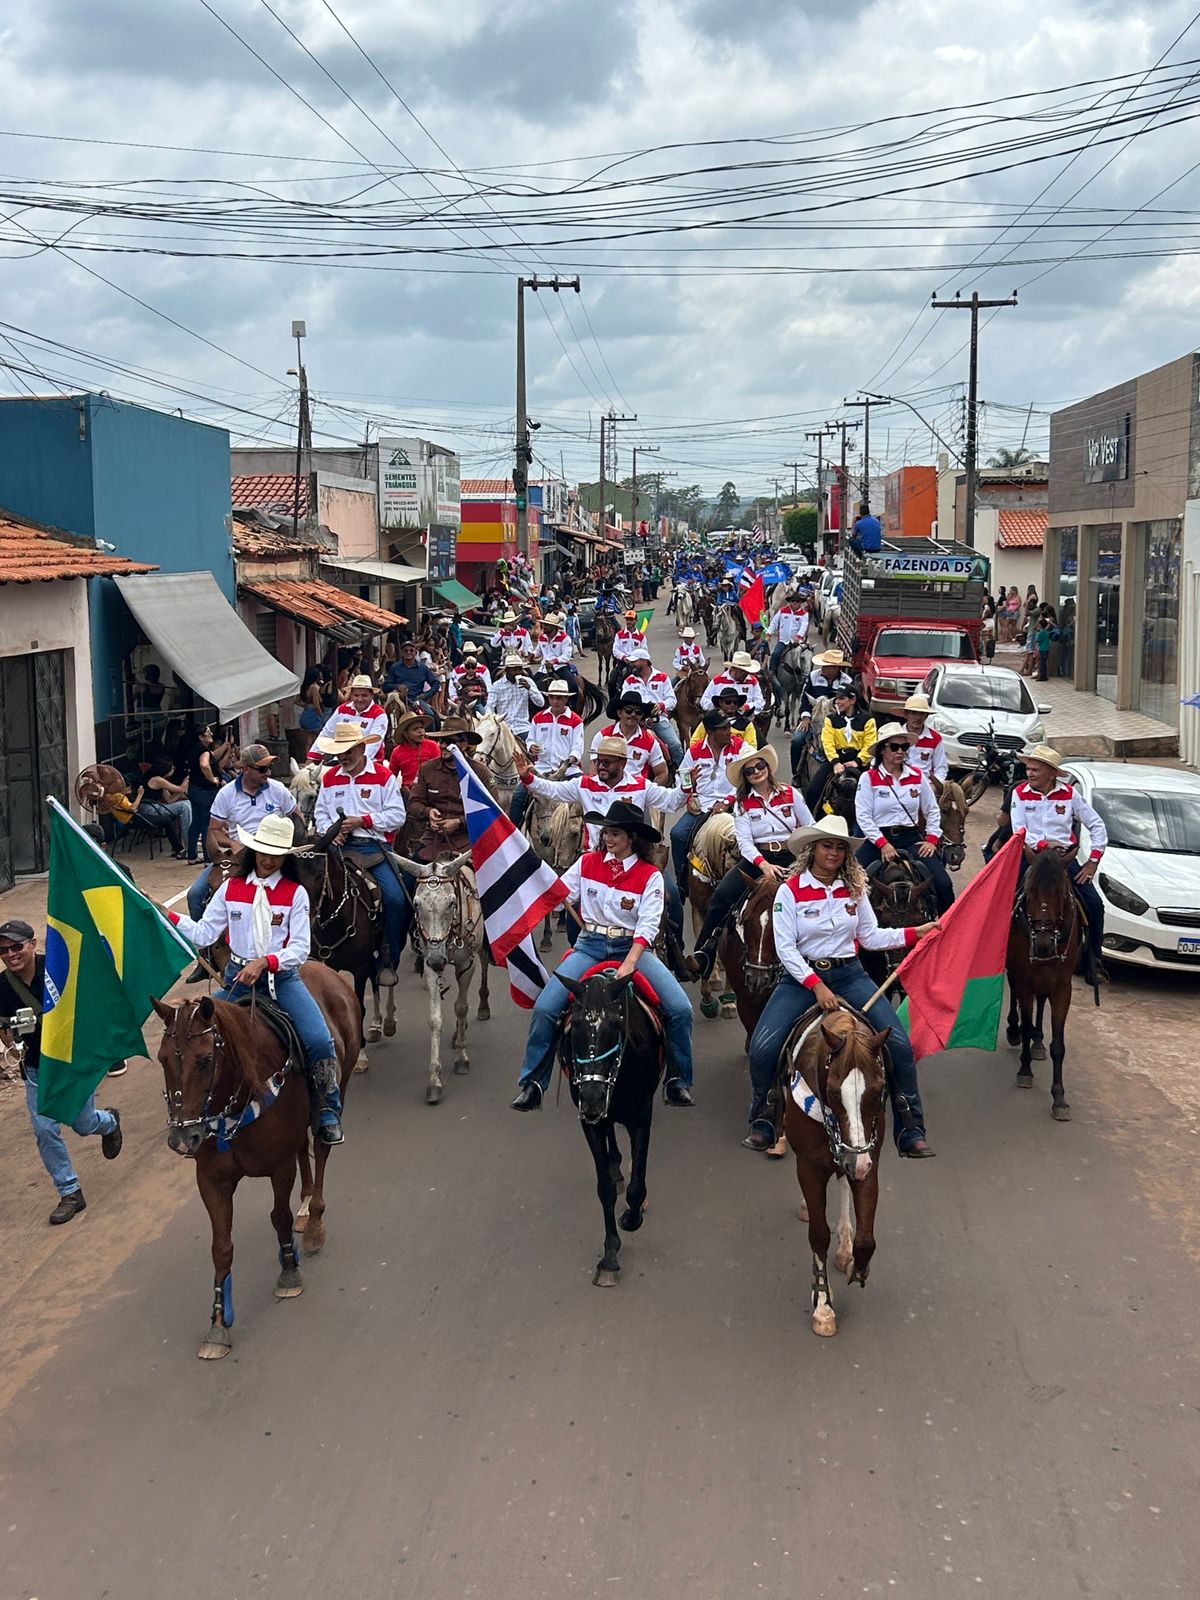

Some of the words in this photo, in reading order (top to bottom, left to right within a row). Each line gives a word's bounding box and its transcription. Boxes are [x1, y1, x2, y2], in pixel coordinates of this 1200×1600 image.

[1100, 435, 1119, 465] VEST
[384, 473, 417, 481] SEMENTES
[884, 558, 950, 573] FAZENDA
[954, 561, 973, 573] DS
